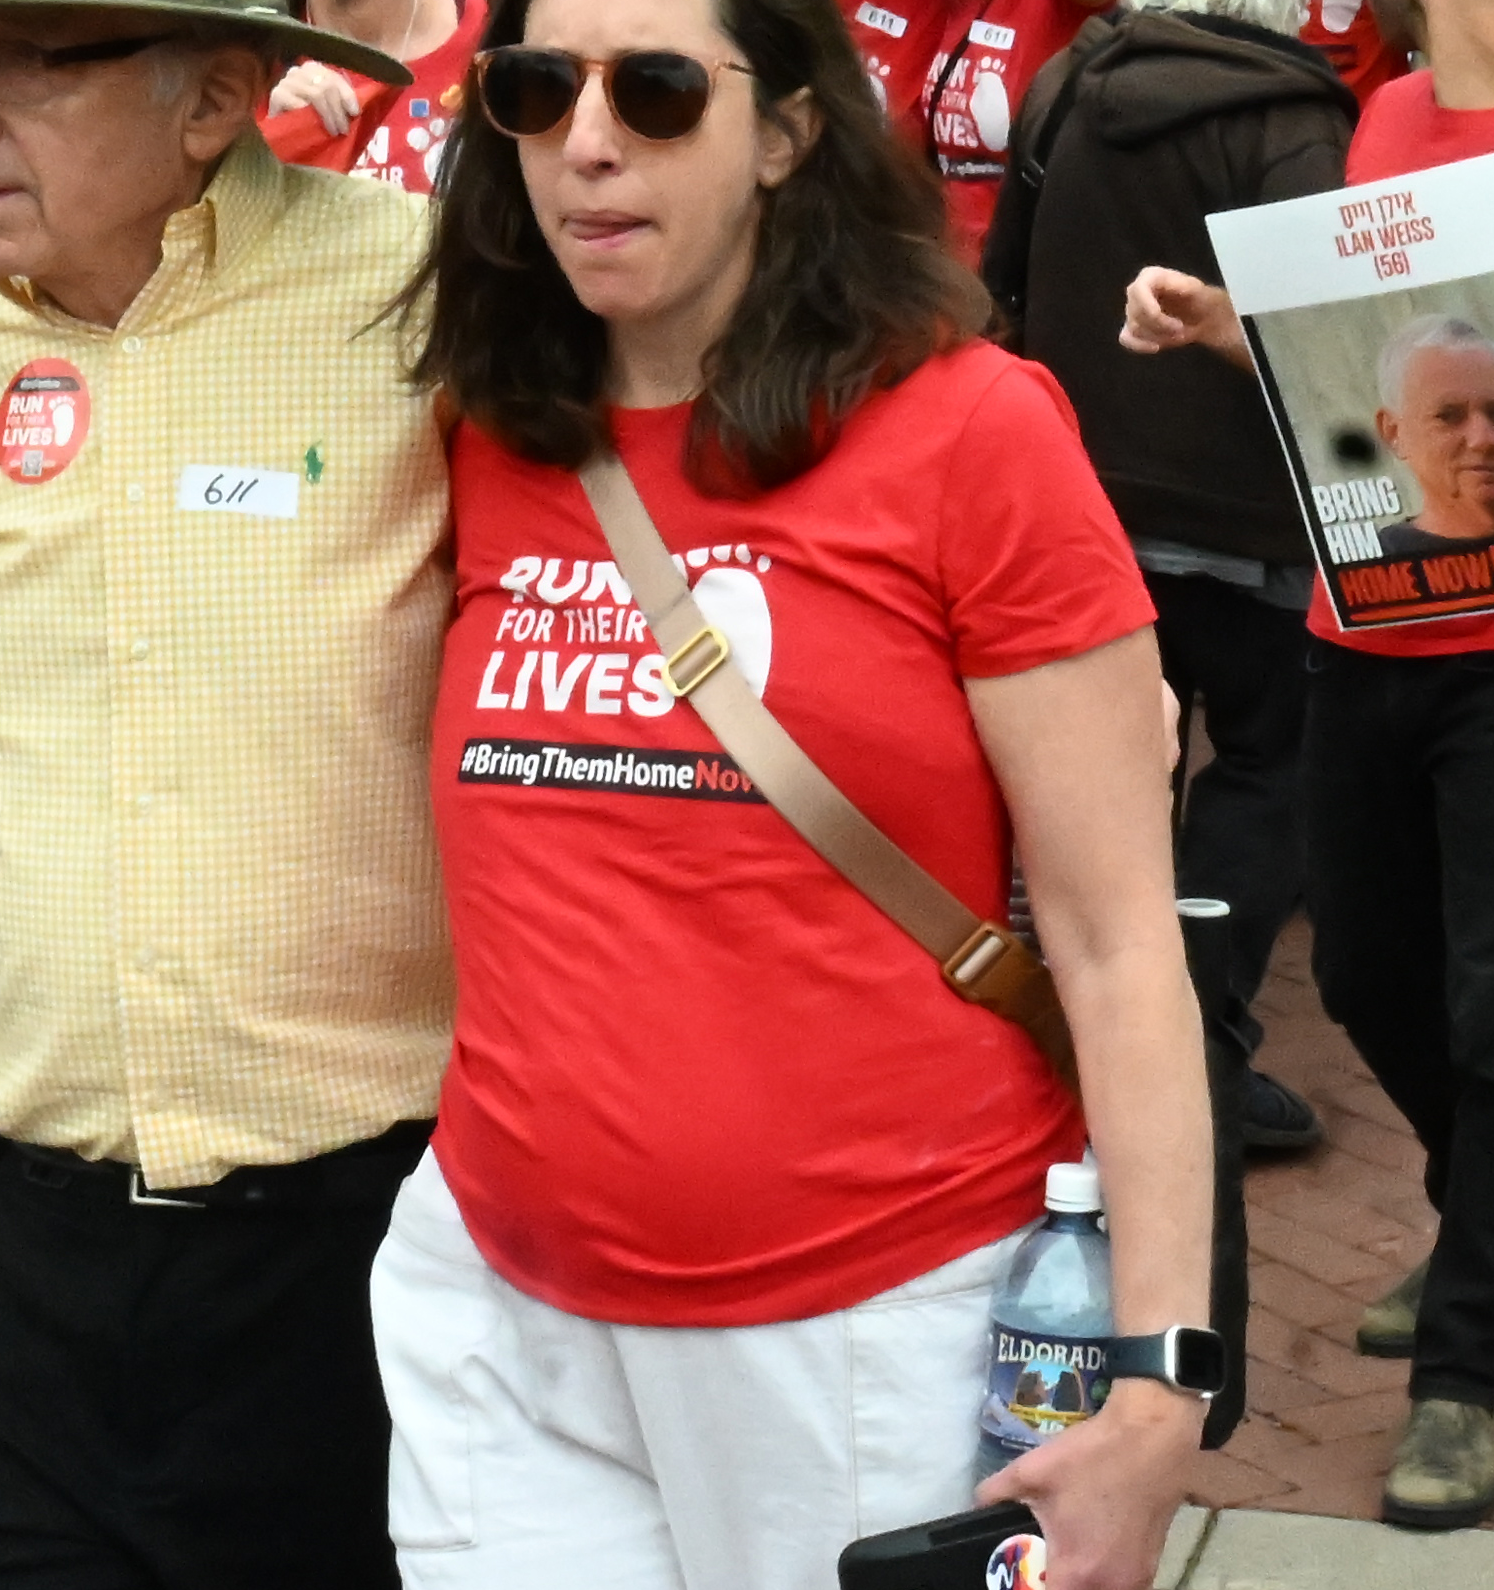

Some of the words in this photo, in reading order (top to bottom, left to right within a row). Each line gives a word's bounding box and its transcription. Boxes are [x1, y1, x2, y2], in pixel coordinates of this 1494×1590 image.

[984, 27, 1009, 43] 611
[1335, 230, 1376, 258] ILAN
[1377, 216, 1435, 249] WEISS
[1374, 249, 1411, 281] (56)
[9, 395, 45, 414] RUN
[2, 427, 53, 447] LIVES
[1311, 476, 1401, 524] BRING
[1323, 521, 1384, 565] HIM
[499, 555, 633, 605] RUN
[1338, 561, 1422, 607] HOME
[495, 608, 554, 642] FOR
[565, 607, 648, 643] THEIR
[476, 650, 675, 717] LIVES
[998, 1332, 1106, 1371] ELDORAD
